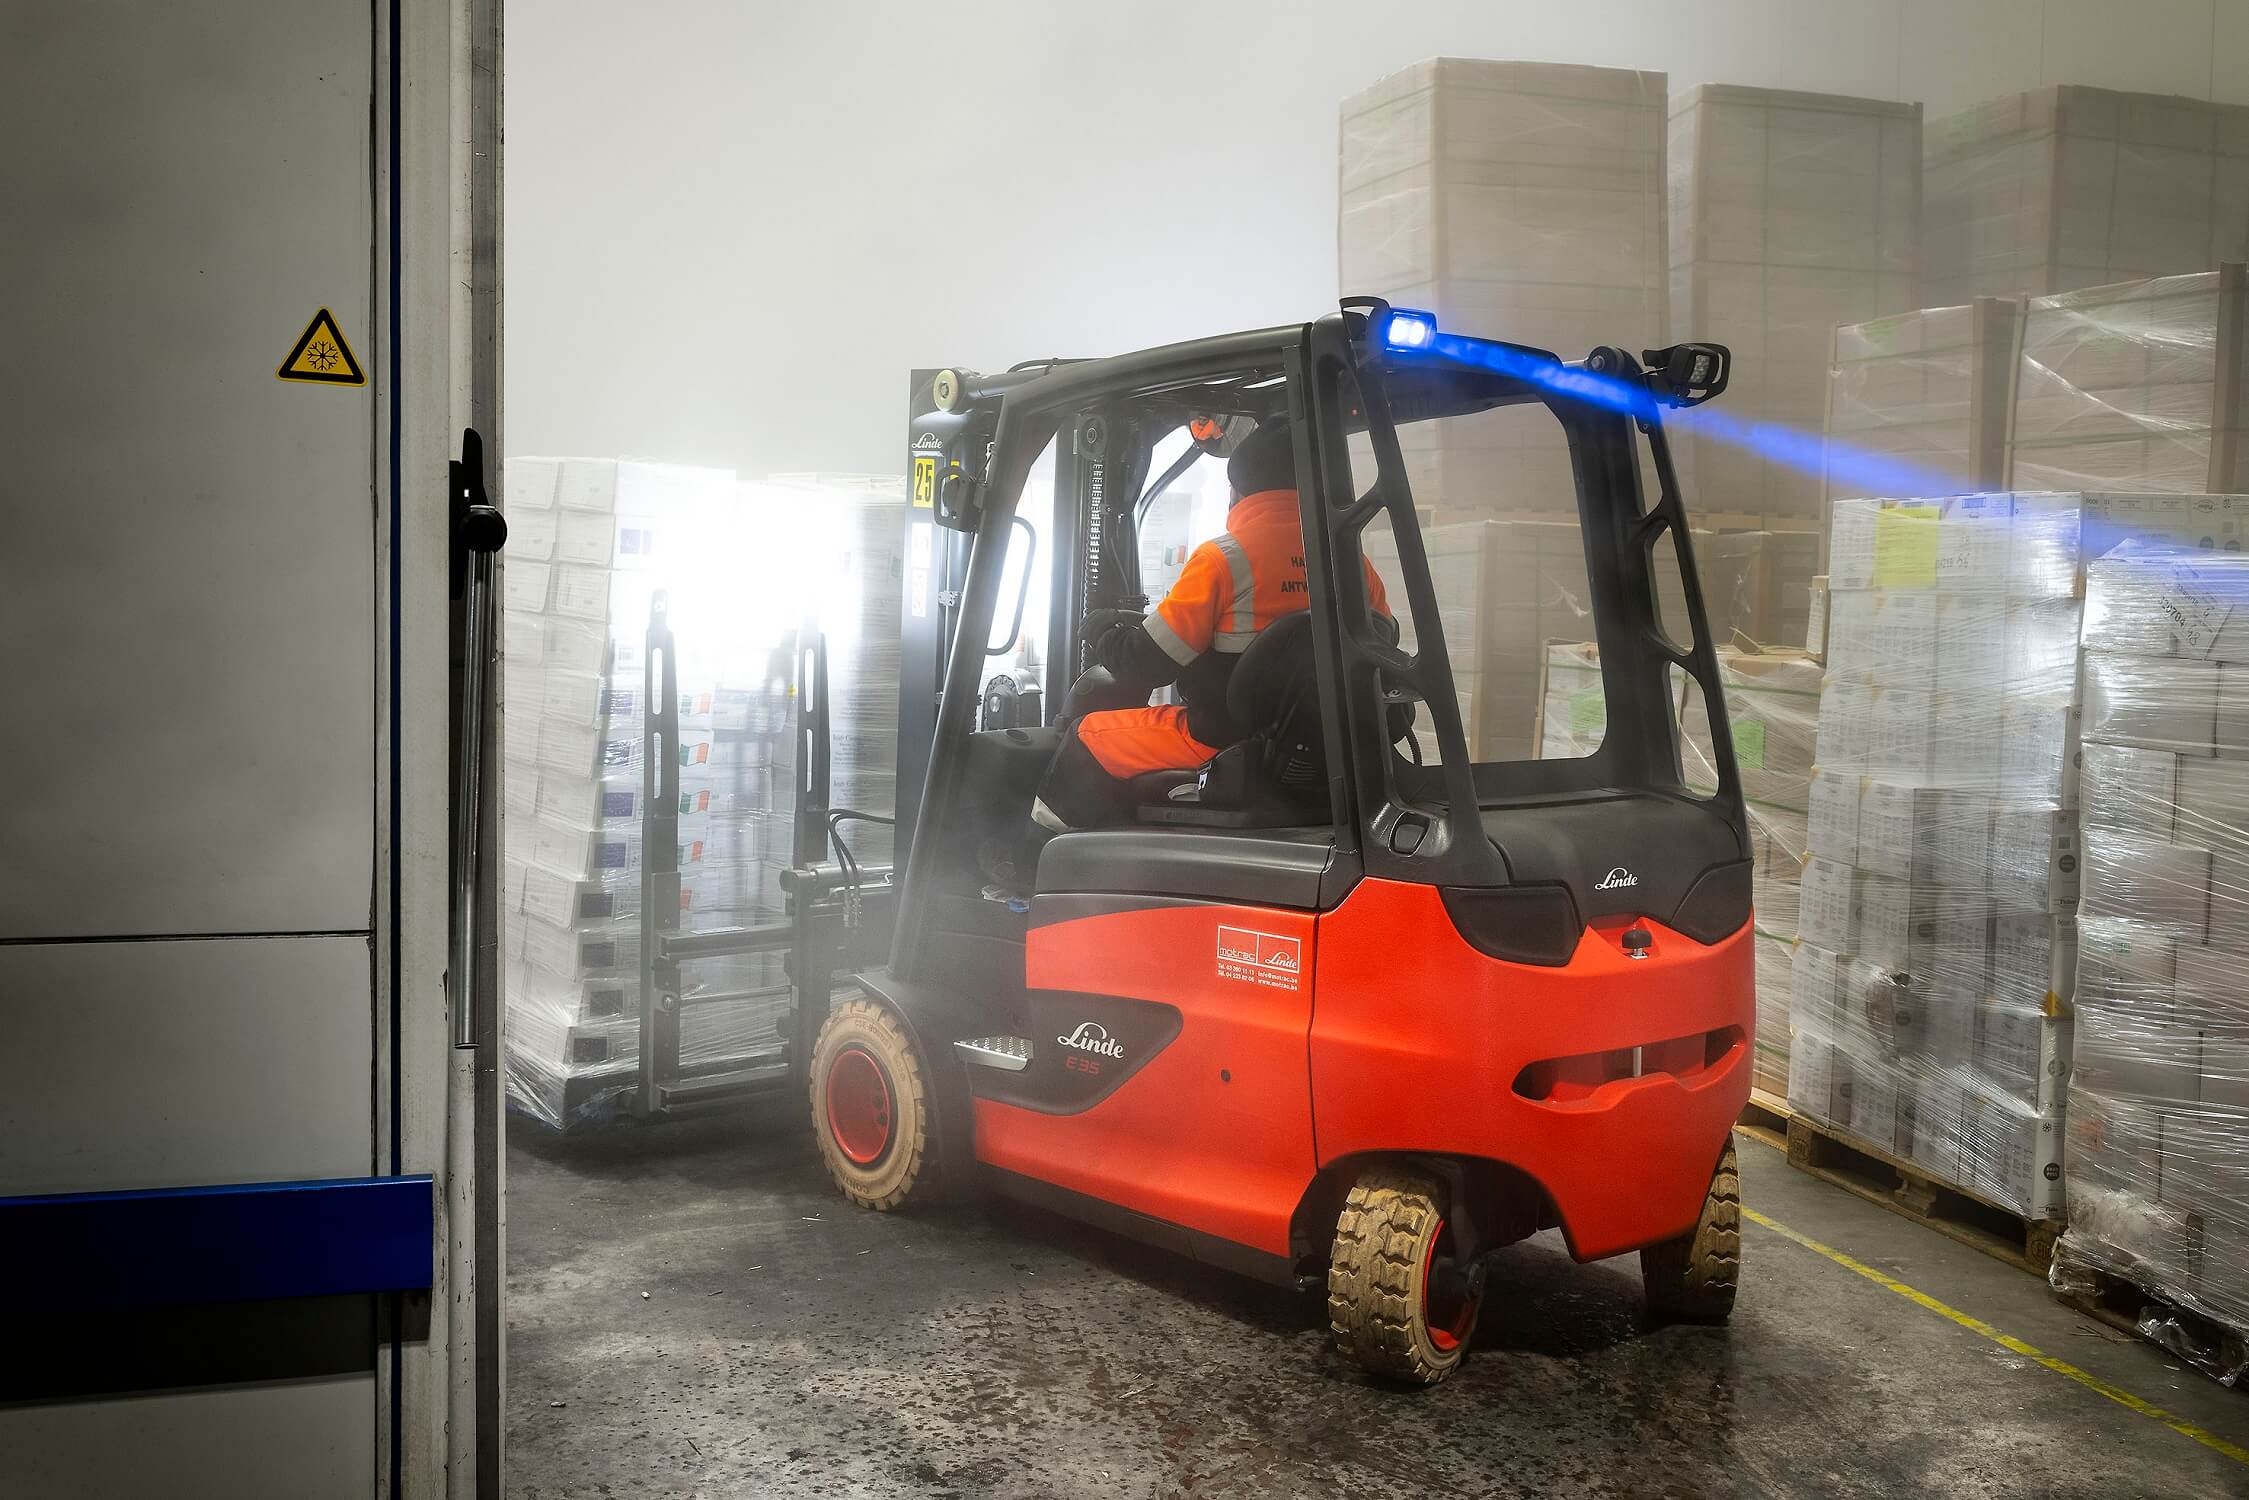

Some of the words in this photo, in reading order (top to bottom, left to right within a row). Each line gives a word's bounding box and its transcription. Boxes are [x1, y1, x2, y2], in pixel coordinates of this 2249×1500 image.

[911, 432, 943, 449] Linde
[915, 462, 933, 502] 25
[1595, 867, 1638, 890] Linde
[1219, 947, 1256, 961] motrac
[1264, 951, 1297, 969] Linde
[1057, 1022, 1124, 1059] Linde
[1065, 1056, 1076, 1070] E
[1079, 1059, 1100, 1075] 35
